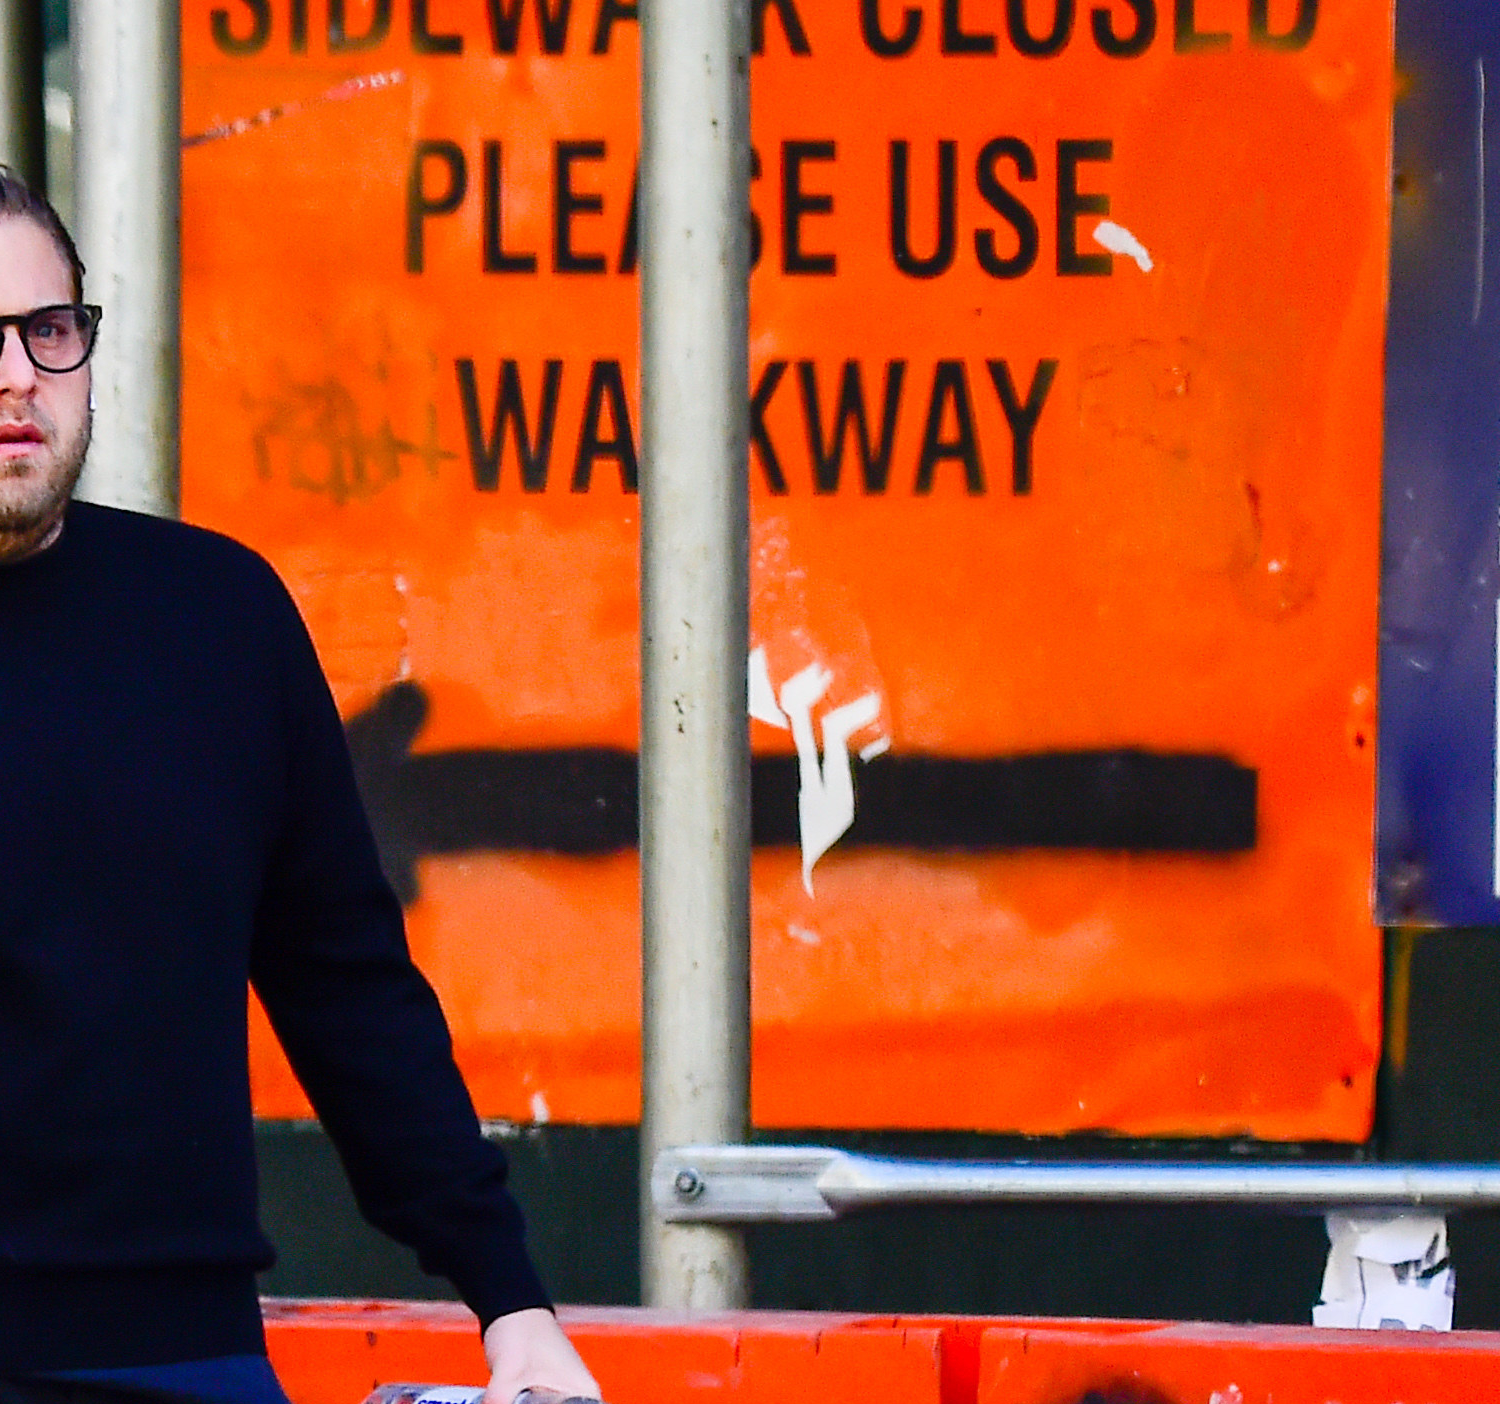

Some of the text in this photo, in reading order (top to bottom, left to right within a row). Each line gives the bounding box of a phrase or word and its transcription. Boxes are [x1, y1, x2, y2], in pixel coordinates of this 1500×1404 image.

[406, 136, 1114, 279] PLEE USE
[454, 358, 1058, 495] WAKWAY
